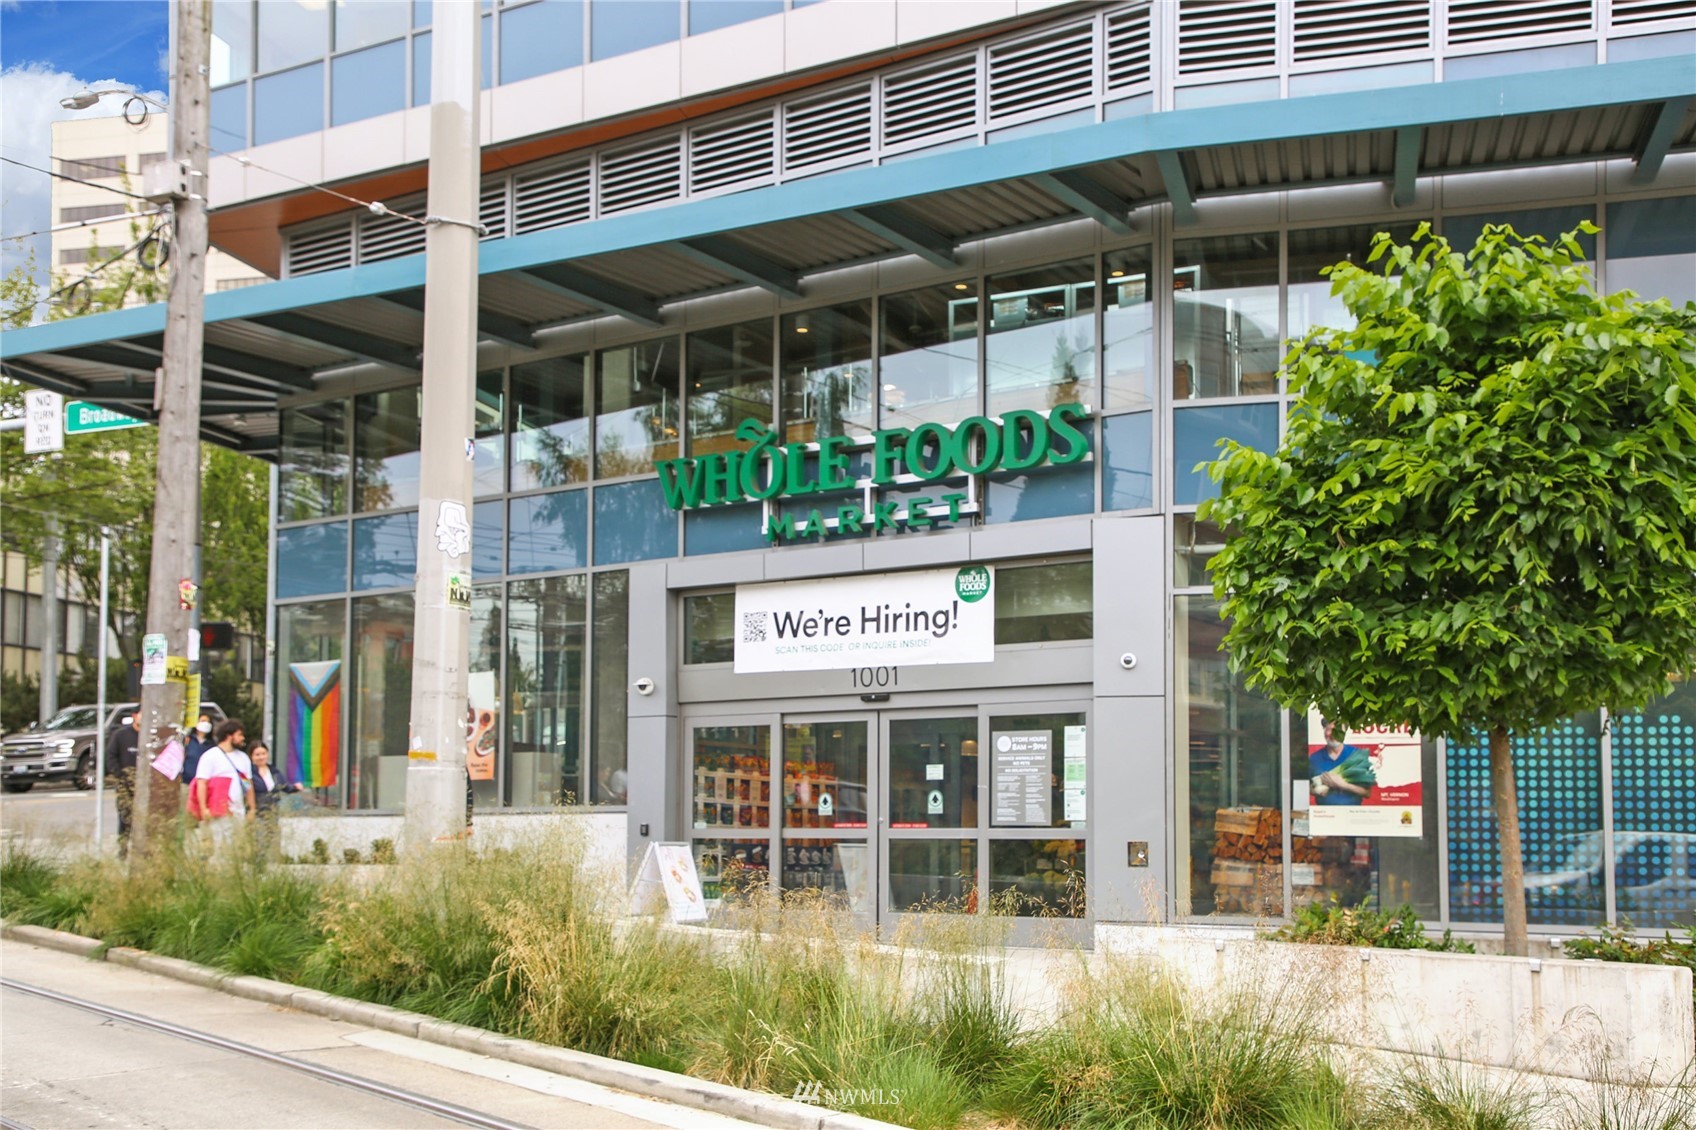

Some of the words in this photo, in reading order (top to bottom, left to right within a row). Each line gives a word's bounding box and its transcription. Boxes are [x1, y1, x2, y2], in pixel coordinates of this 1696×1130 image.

[653, 418, 858, 511] WHOLE
[871, 402, 1089, 484] FOODS
[764, 494, 968, 542] MARKET
[958, 570, 988, 583] WHOLE
[959, 582, 987, 591] FOODS
[773, 609, 851, 639] We're
[860, 600, 959, 638] Hiring!
[775, 646, 799, 655] SCAN
[801, 644, 819, 653] THIS
[820, 643, 844, 653] CODE
[848, 642, 861, 651] OR
[862, 640, 897, 650] INQUIRE
[850, 666, 899, 688] 1001
